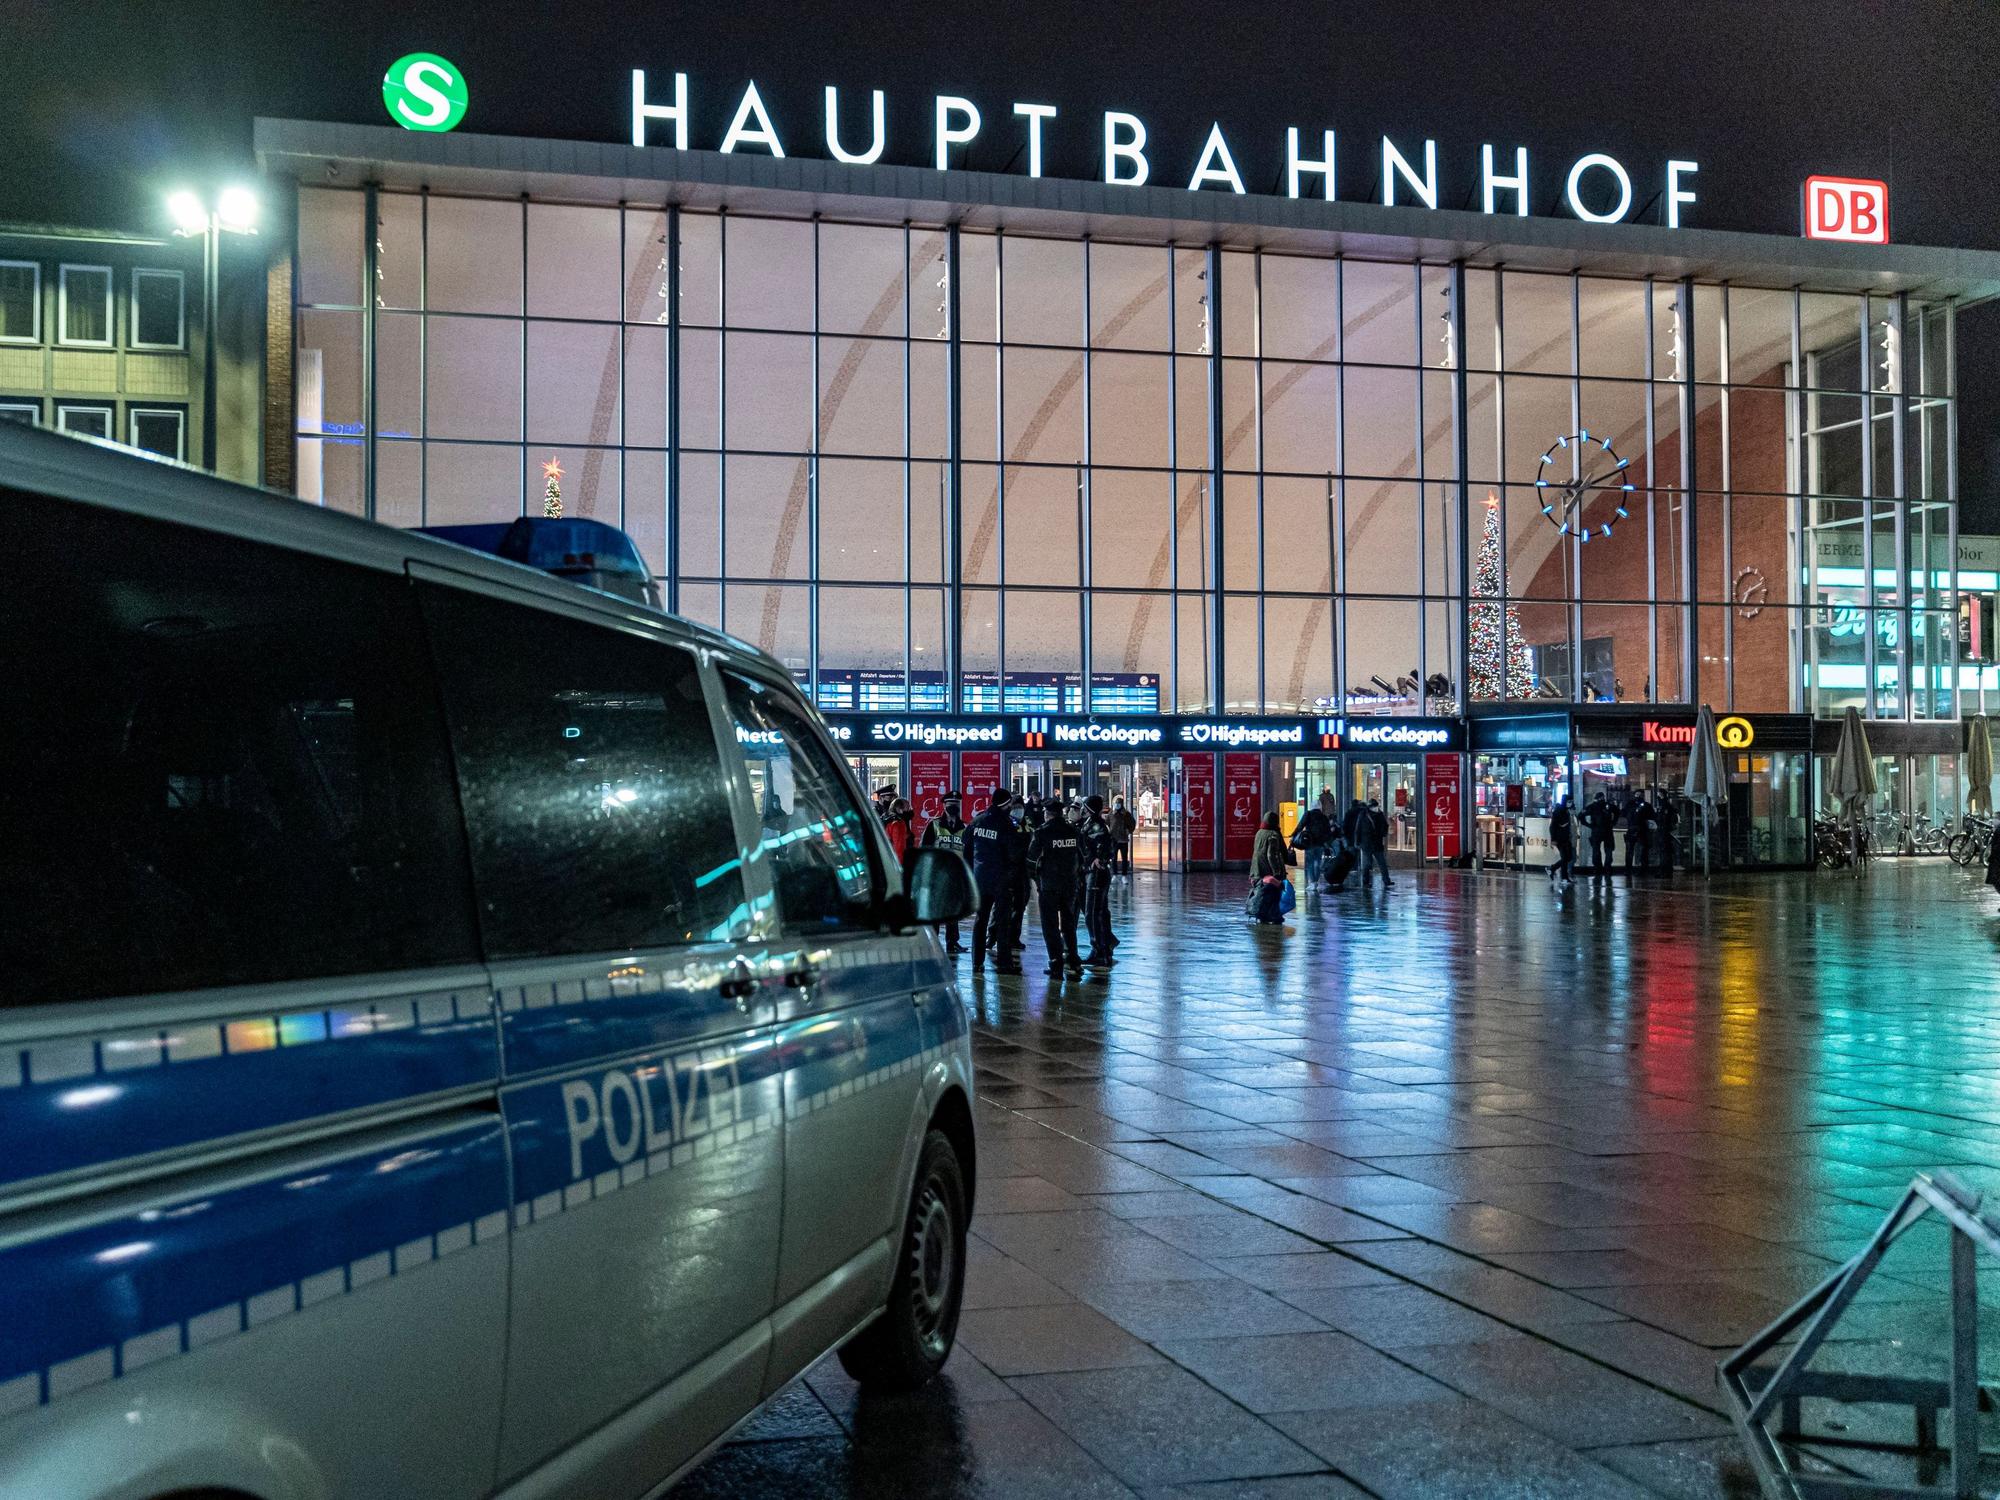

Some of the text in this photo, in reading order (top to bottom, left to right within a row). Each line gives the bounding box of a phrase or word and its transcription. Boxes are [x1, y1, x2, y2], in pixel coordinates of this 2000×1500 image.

[397, 61, 453, 127] S
[632, 69, 1699, 229] HAUPTBAHNHOF
[1817, 188, 1878, 235] DB
[904, 723, 1003, 745] Highspeed
[1055, 724, 1161, 746] NetCologne
[1211, 725, 1302, 746] Highspeed
[1350, 725, 1448, 746] NetCologne
[973, 827, 998, 841] POLIZEI
[1052, 838, 1077, 849] POLIZEI
[562, 1048, 742, 1179] POLIZEI
